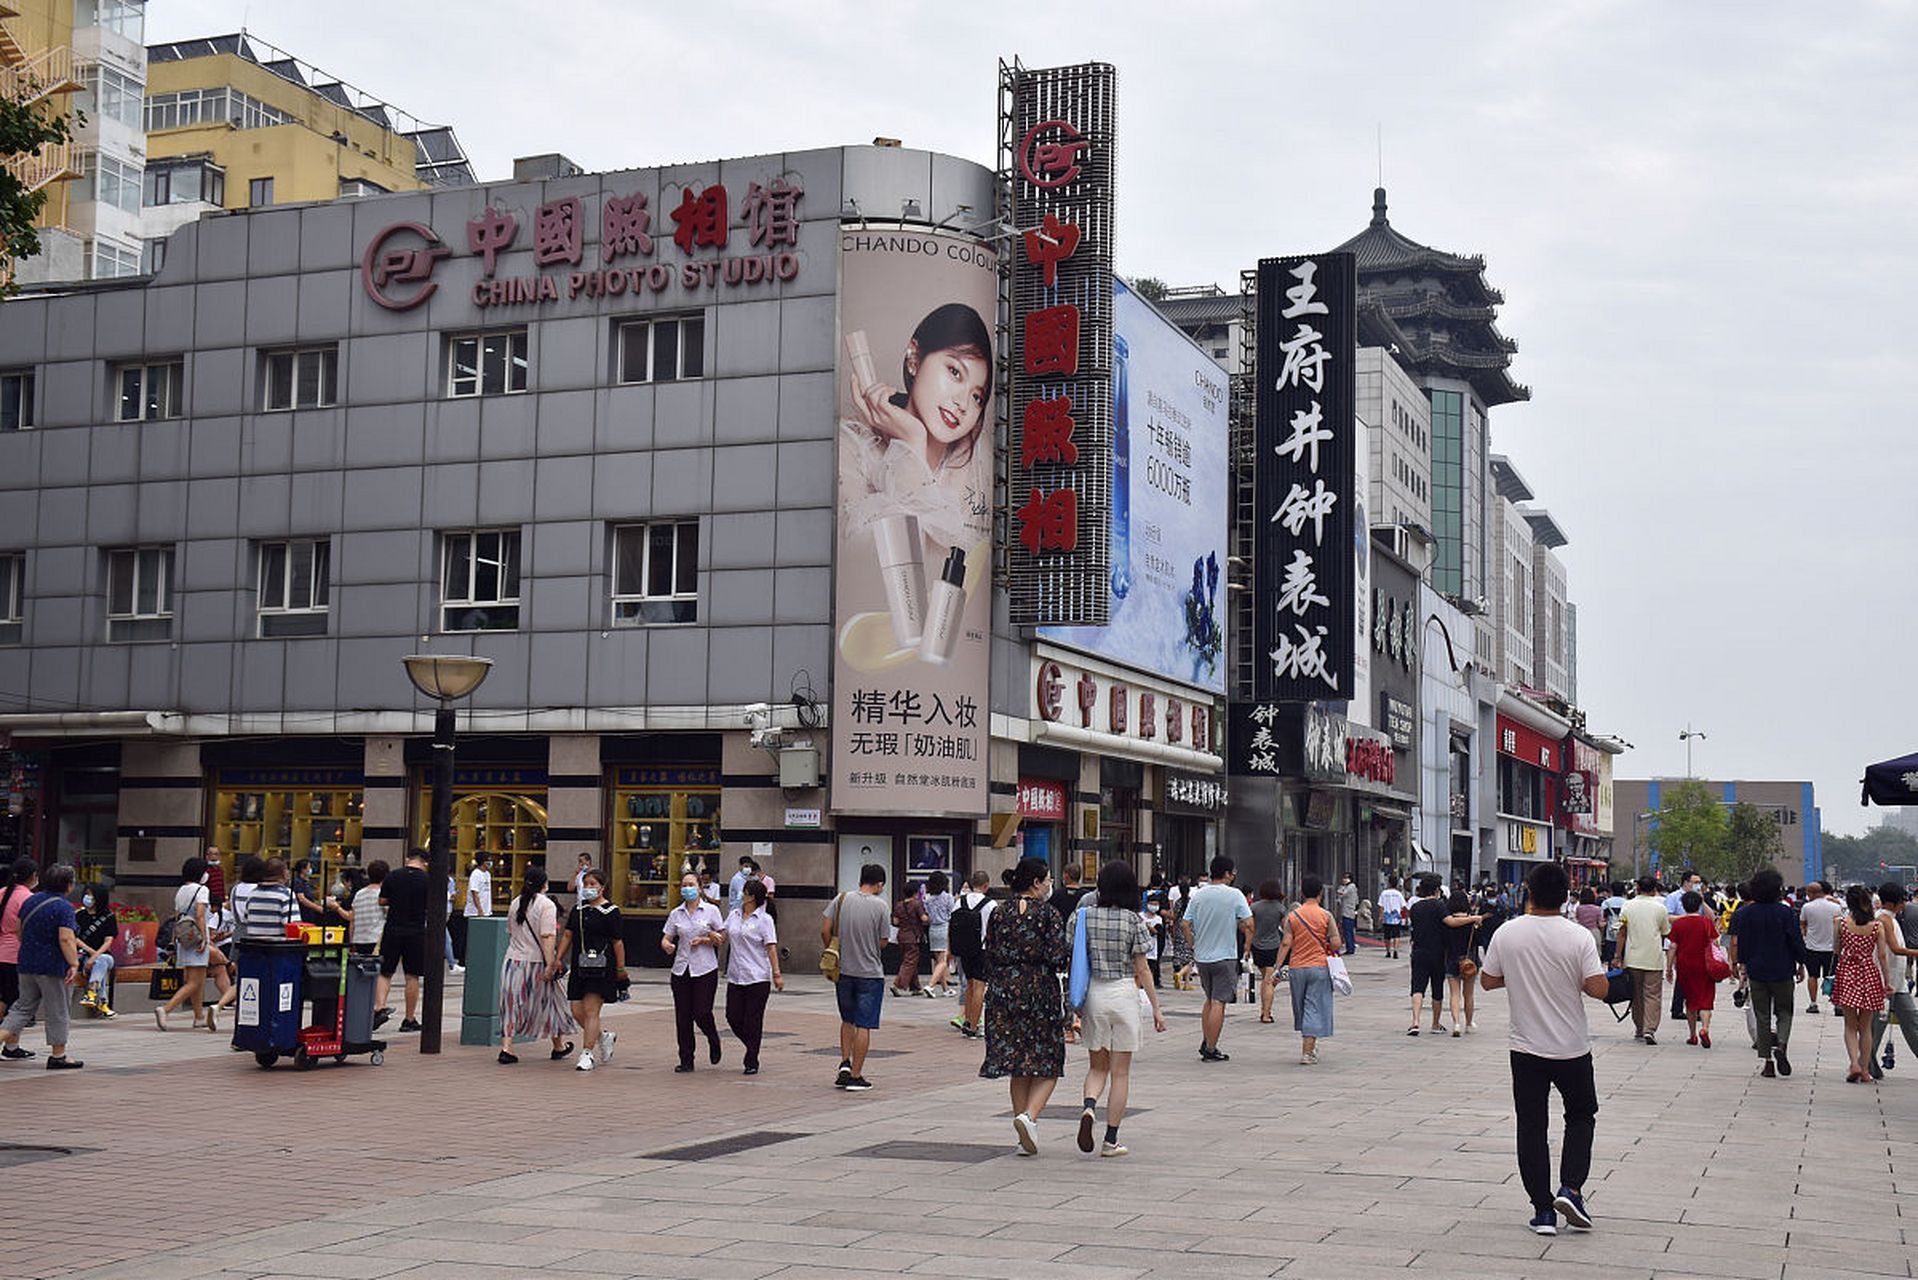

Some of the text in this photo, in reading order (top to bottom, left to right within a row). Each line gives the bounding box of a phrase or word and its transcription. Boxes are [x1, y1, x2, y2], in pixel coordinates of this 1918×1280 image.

[842, 236, 939, 256] CHANDO
[471, 252, 800, 308] CHINA PHOTO STUDIO
[1018, 213, 1080, 555] 中國照相
[1269, 260, 1339, 692] 王府井钟表城
[851, 689, 978, 729] 精华入妆
[1248, 703, 1280, 775] 钟表城
